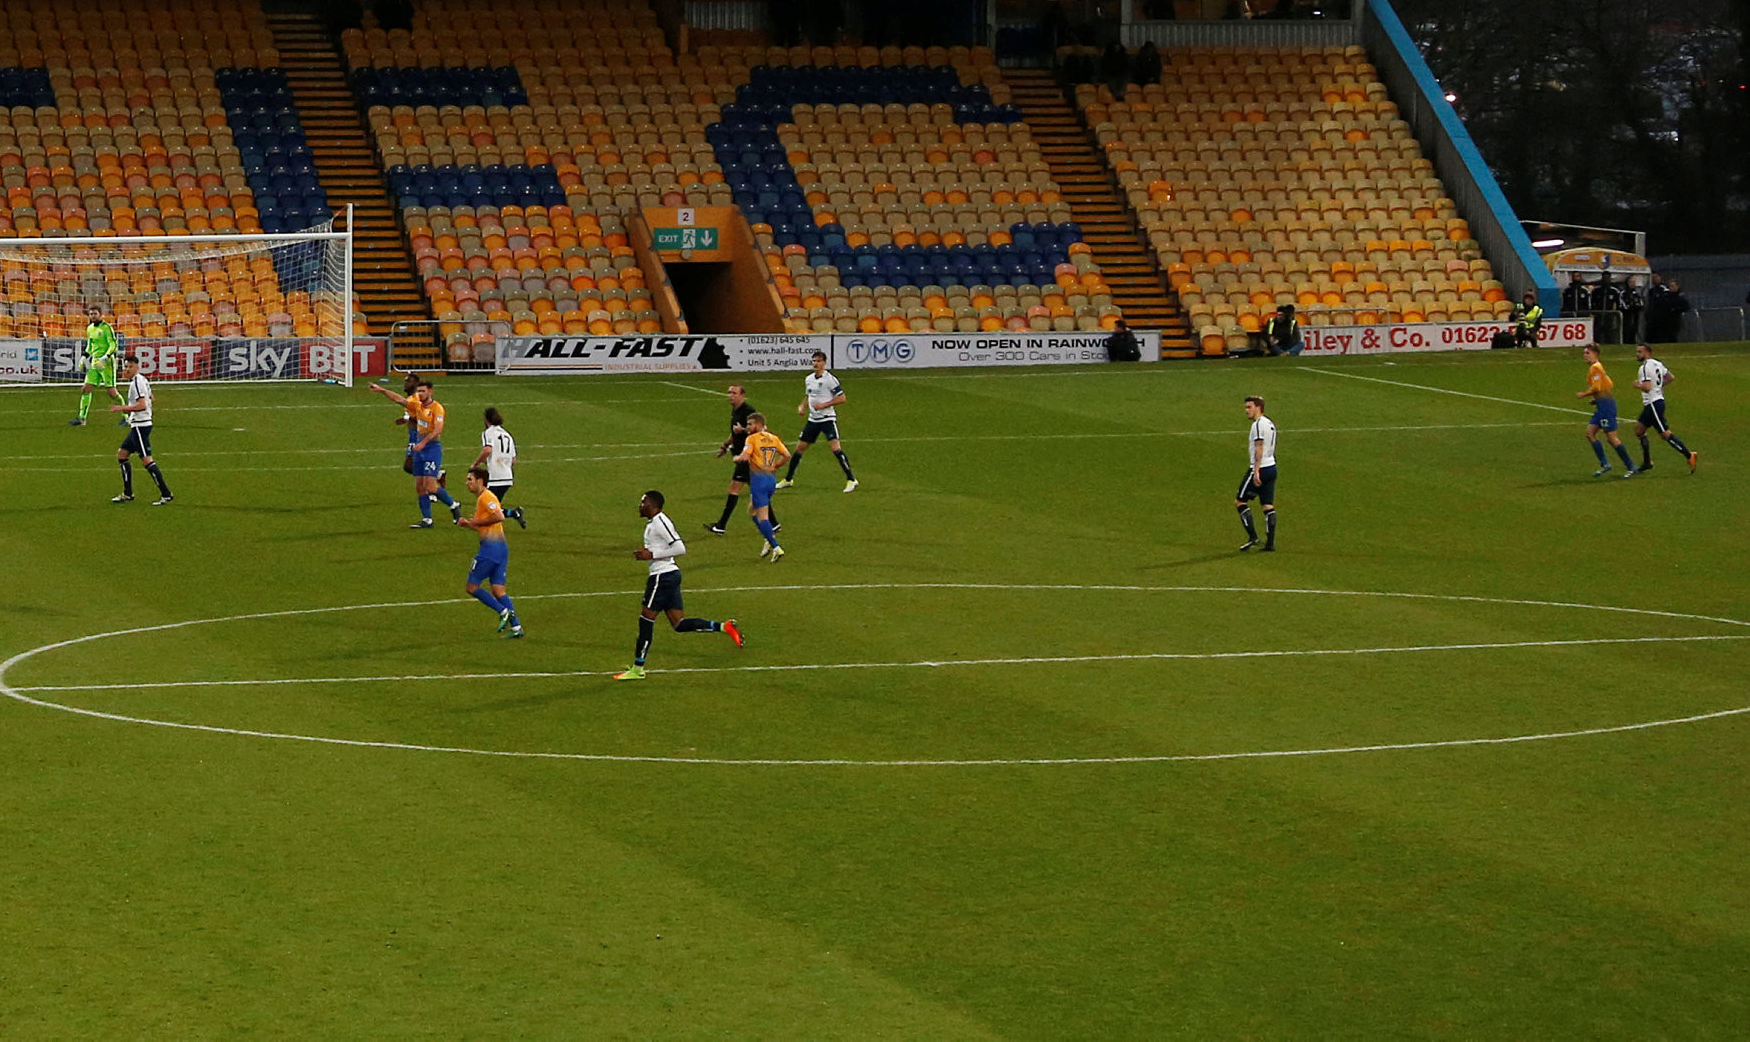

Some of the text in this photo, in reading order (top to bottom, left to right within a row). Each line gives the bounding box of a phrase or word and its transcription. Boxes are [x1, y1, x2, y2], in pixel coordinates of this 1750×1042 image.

[682, 212, 690, 222] 2
[658, 235, 678, 243] EXIT
[1360, 328, 1381, 349] &
[1389, 327, 1431, 348] Co.
[931, 339, 971, 350] NOW
[976, 339, 1021, 349] OPEN
[1026, 339, 1043, 348] IN
[135, 346, 201, 374] BET
[228, 340, 377, 378] sky BET
[958, 351, 990, 361] Over
[995, 351, 1024, 361] 300
[1029, 350, 1060, 360] Cars
[1066, 351, 1076, 360] in
[605, 363, 652, 371] INDUSTRIAL
[748, 358, 765, 367] Unit
[497, 433, 511, 454] 17
[760, 446, 777, 467] 17
[424, 461, 436, 471] 24
